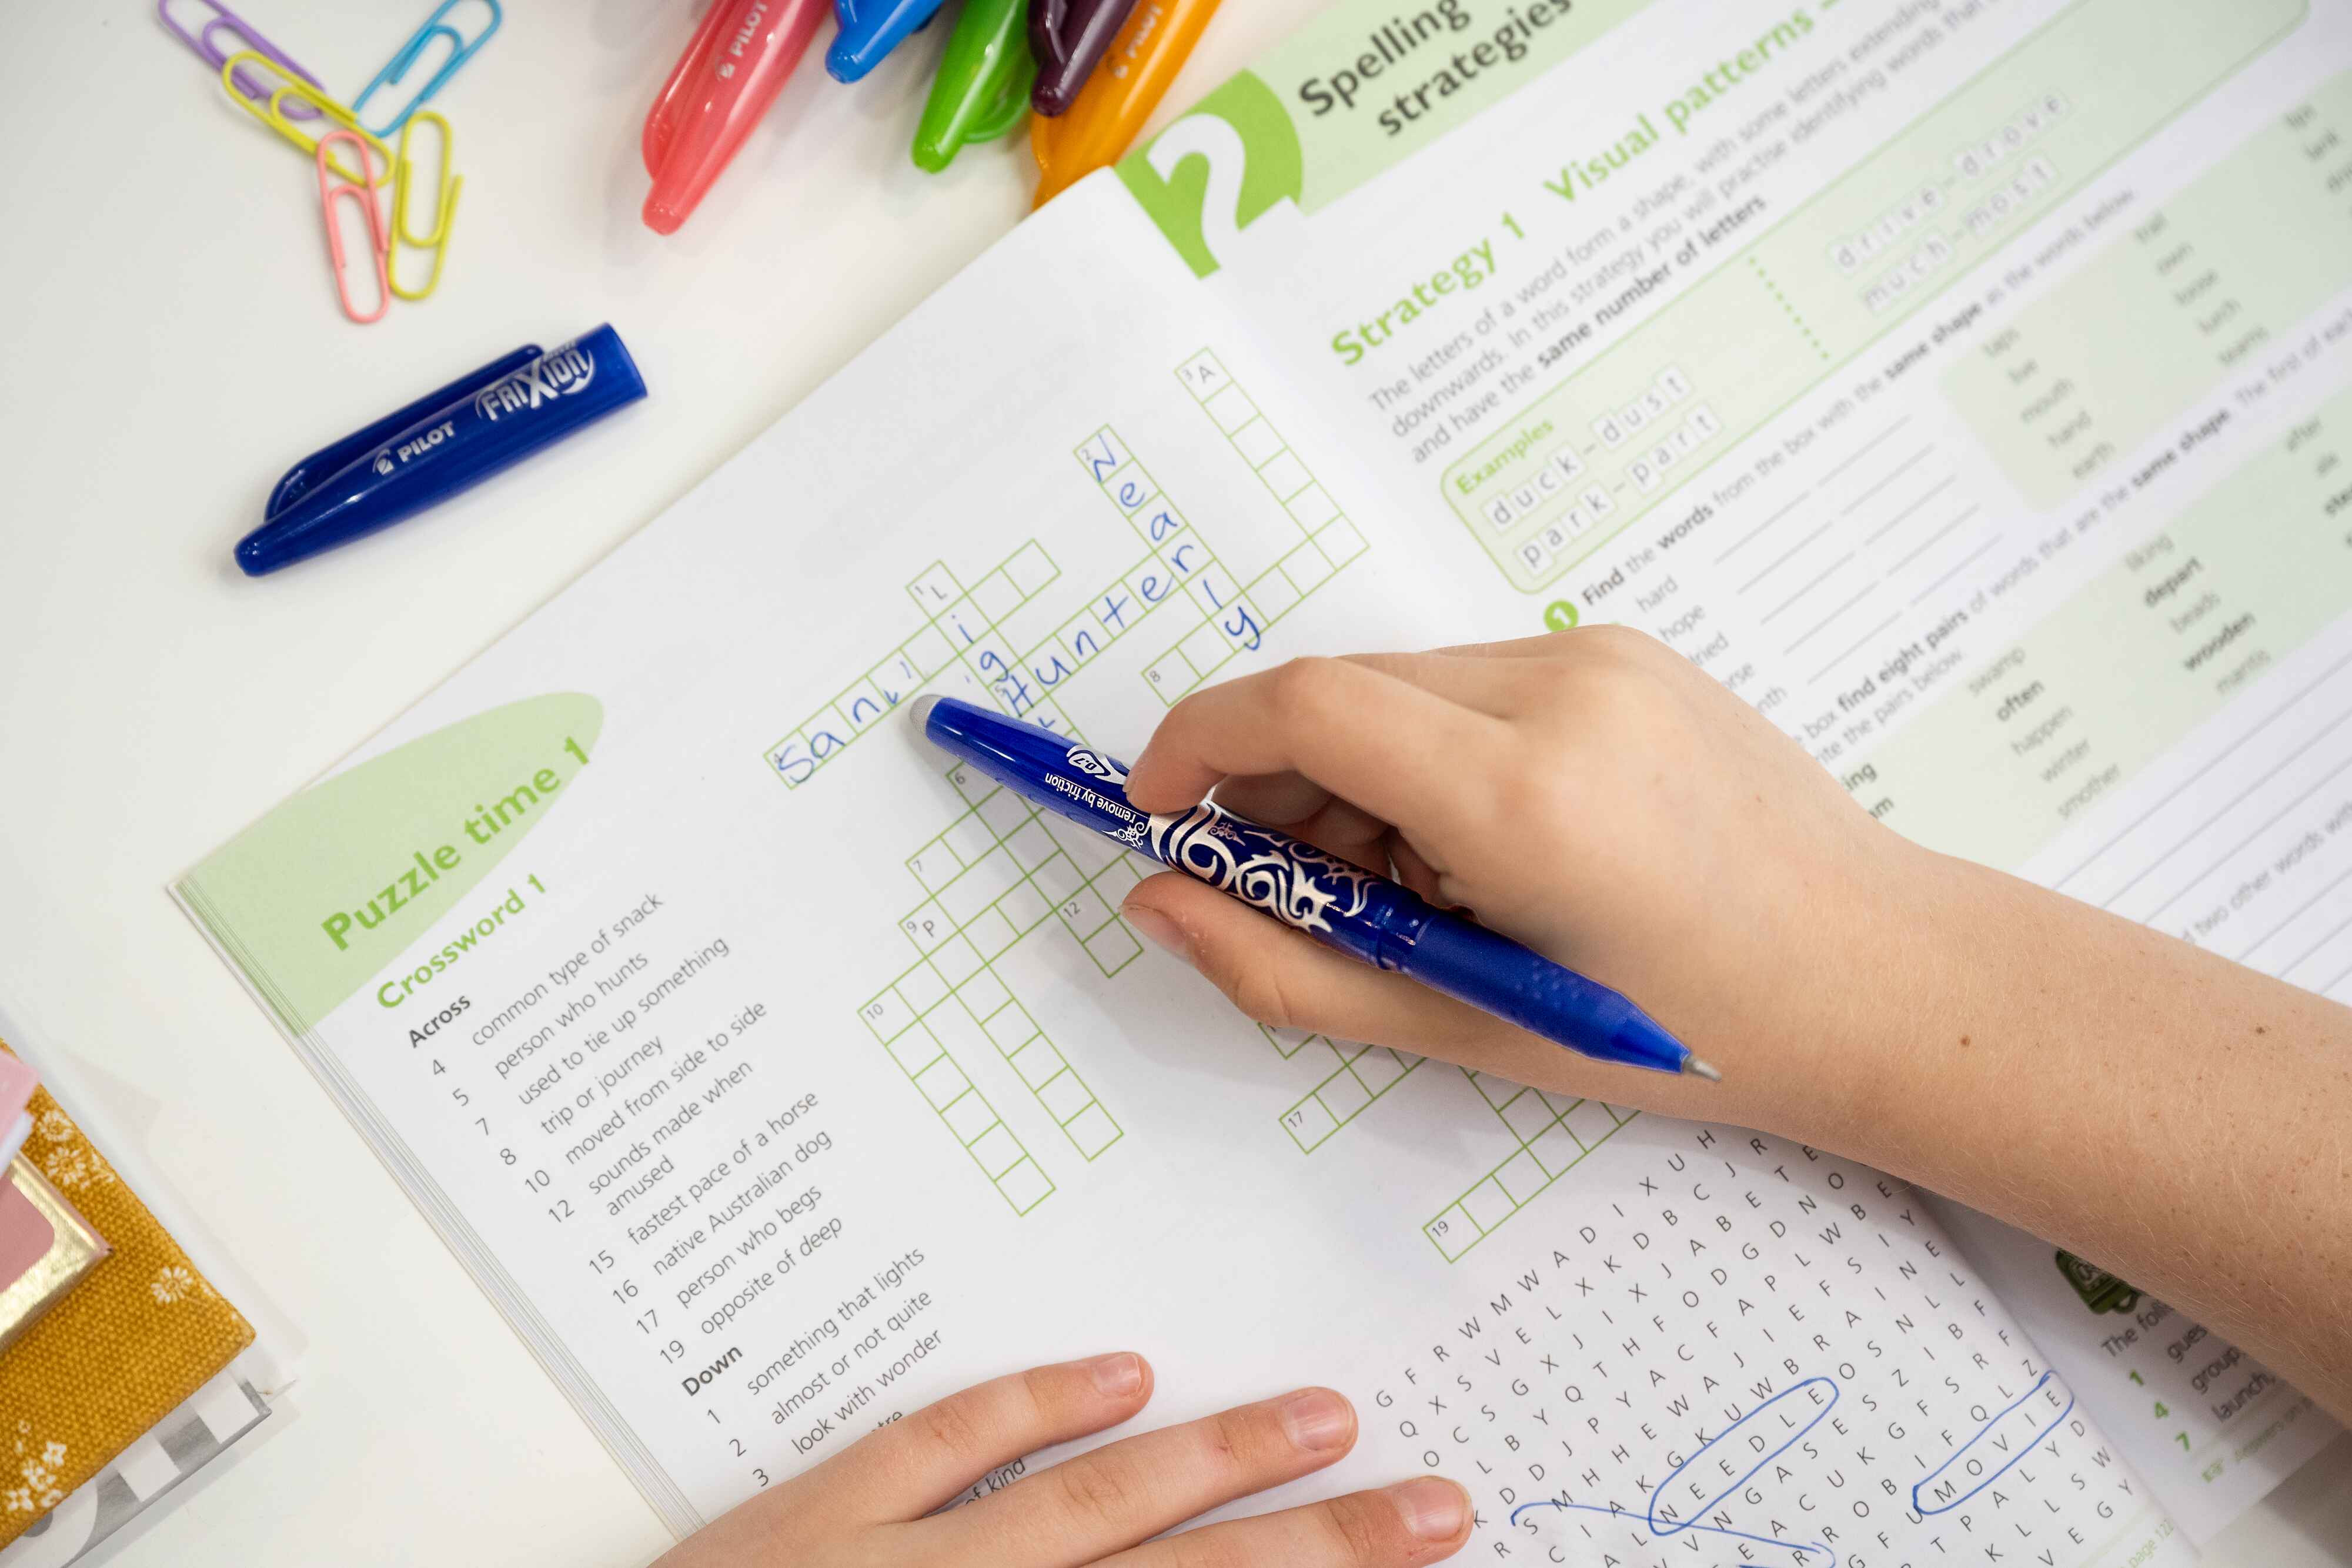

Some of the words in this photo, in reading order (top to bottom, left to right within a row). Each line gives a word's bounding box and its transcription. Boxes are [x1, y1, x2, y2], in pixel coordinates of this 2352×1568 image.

[730, 0, 767, 57] PILOT
[1298, 0, 1471, 117] Spelling
[1378, 0, 1572, 136] strategies
[1146, 112, 1294, 272] 2
[1331, 238, 1495, 366] Strategy
[1502, 212, 1525, 239] 1
[1543, 114, 1659, 202] Visual
[1664, 11, 1815, 136] patterns
[1411, 423, 1452, 464] and
[1448, 391, 1501, 432] have
[1499, 364, 1536, 395] the
[1536, 322, 1592, 369] same
[1594, 262, 1672, 326] number
[1675, 237, 1700, 267] of
[1368, 379, 1412, 412] The
[397, 422, 456, 463] PILOT
[1454, 421, 1554, 496] Examples
[1581, 566, 1625, 607] Find
[1624, 547, 1656, 574] the
[1656, 504, 1715, 550] words
[1883, 342, 1930, 381] same
[1931, 302, 1983, 346] shape
[1635, 573, 1678, 611] hard
[2143, 557, 2204, 610] depart
[1000, 544, 1195, 716] Hunter
[1659, 601, 1708, 645] hope
[2182, 611, 2256, 672] wooden
[1836, 676, 1877, 713] find
[1877, 641, 1926, 684] eight
[1925, 609, 1969, 651] pairs
[1993, 677, 2045, 721] often
[1045, 771, 1081, 801] friction
[1074, 757, 1097, 771] 0.7
[320, 844, 462, 951] Puzzle
[463, 768, 561, 845] time
[564, 736, 589, 765] 1
[1096, 798, 1136, 823] remove
[376, 888, 526, 1009] Crossword
[527, 873, 546, 894] 1
[921, 920, 935, 938] P
[1063, 901, 1081, 919] 12
[408, 995, 471, 1049] Across
[433, 1059, 446, 1076] 4
[472, 984, 549, 1046] common
[548, 951, 590, 987] type
[590, 928, 612, 954] of
[612, 893, 664, 938] snack
[866, 1003, 884, 1020] 10
[452, 1088, 469, 1107] 5
[494, 1026, 556, 1081] person
[554, 994, 596, 1028] who
[594, 952, 649, 997] hunts
[475, 1116, 489, 1136] 7
[518, 1064, 562, 1105] used
[561, 1051, 584, 1071] to
[583, 1031, 610, 1053] tie
[611, 1009, 637, 1033] up
[637, 938, 730, 1013] something
[499, 1147, 517, 1166] 8
[540, 1106, 574, 1135] trip
[576, 1087, 596, 1109] or
[594, 1035, 664, 1097] journey
[524, 1169, 550, 1193] 10
[564, 1109, 626, 1165] moved
[623, 1079, 670, 1117] from
[670, 1050, 707, 1083] side
[706, 1032, 730, 1052] to
[730, 1002, 767, 1036] side
[1287, 1110, 1303, 1128] 17
[548, 1199, 575, 1223] 12
[588, 1141, 652, 1195] sounds
[652, 1102, 703, 1145] made
[701, 1062, 753, 1104] when
[589, 1249, 614, 1275] 15
[627, 1195, 689, 1245] fastest
[687, 1162, 731, 1203] pace
[732, 1138, 753, 1165] of
[754, 1132, 770, 1147] a
[766, 1093, 819, 1135] horse
[606, 1154, 675, 1216] amused
[612, 1279, 639, 1305] 16
[652, 1229, 707, 1276] native
[708, 1161, 794, 1233] Australian
[794, 1131, 833, 1163] dog
[636, 1309, 659, 1335] 17
[676, 1255, 737, 1310] person
[736, 1221, 778, 1256] who
[775, 1185, 822, 1225] begs
[1427, 1219, 1450, 1239] 19
[659, 1340, 685, 1364] 19
[701, 1272, 775, 1335] opposite
[776, 1248, 797, 1275] of
[799, 1218, 842, 1257] deep
[681, 1346, 743, 1397] Down
[707, 1409, 721, 1425] 1
[747, 1318, 840, 1396] something
[837, 1286, 877, 1321] that
[873, 1248, 925, 1292] lights
[2101, 1327, 2138, 1357] The
[729, 1438, 747, 1458] 2
[771, 1372, 831, 1425] almost
[831, 1354, 851, 1376] or
[853, 1327, 887, 1359] not
[886, 1292, 932, 1332] quite
[752, 1468, 770, 1487] 3
[790, 1418, 836, 1455] look
[833, 1386, 876, 1421] with
[875, 1329, 941, 1388] wonder
[2129, 1369, 2143, 1387] 1
[985, 1458, 1026, 1493] kind
[2175, 1430, 2190, 1451] 7
